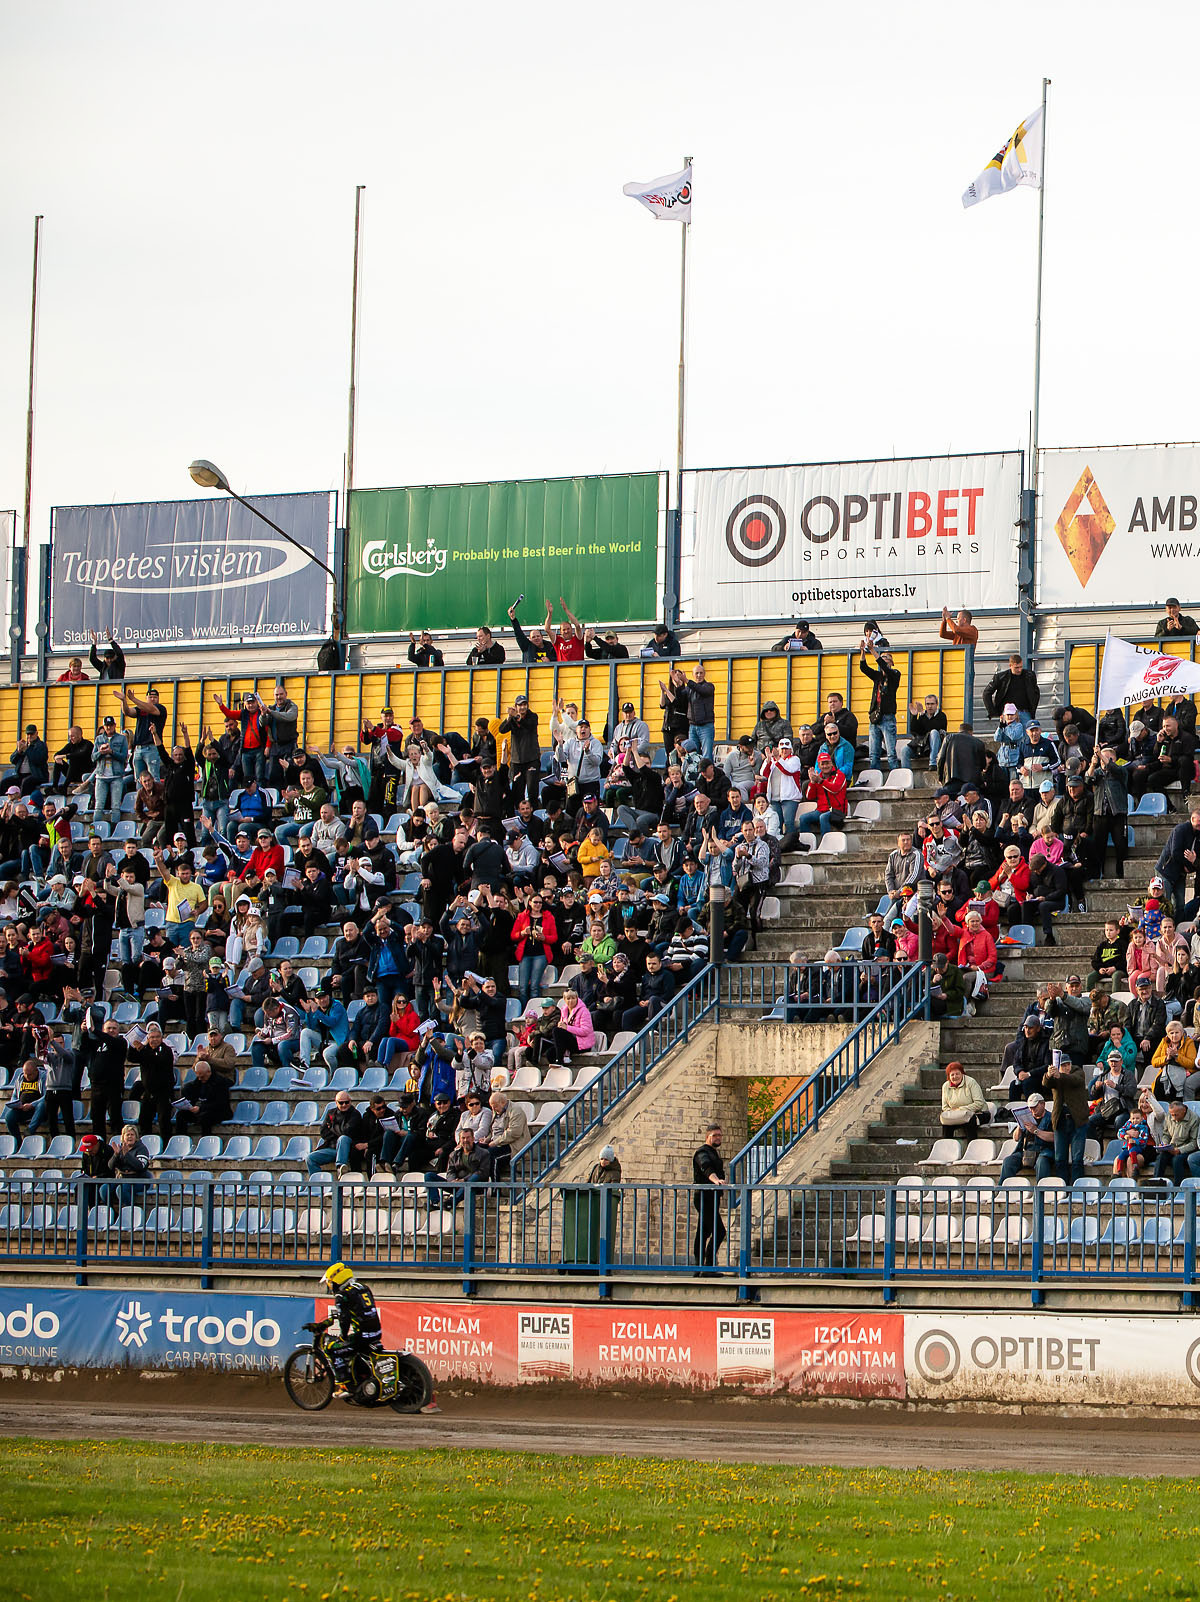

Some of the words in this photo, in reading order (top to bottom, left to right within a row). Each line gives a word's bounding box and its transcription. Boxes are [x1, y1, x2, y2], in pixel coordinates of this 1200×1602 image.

[800, 488, 984, 543] OPTIBET
[362, 540, 448, 578] Carlsberg
[452, 550, 500, 562] Probably
[502, 548, 519, 559] the
[523, 547, 545, 558] Best
[549, 545, 573, 557] Beer
[576, 544, 586, 555] in
[588, 544, 606, 555] the
[609, 541, 641, 553] World
[803, 546, 898, 561] SPORTA
[917, 542, 980, 556] BĀRS
[63, 550, 166, 594] Tapetes
[174, 548, 262, 577] visiem
[792, 584, 916, 604] optibetsportabars.lv
[124, 625, 184, 643] Daugavpils
[192, 619, 310, 638] www.zila-ezerzeme.lv
[1123, 685, 1188, 706] DAUGAVPILS
[362, 1294, 372, 1306] 5
[0, 1303, 59, 1339] do
[159, 1308, 281, 1347] trodo
[417, 1315, 481, 1335] IZCILAM
[521, 1317, 570, 1335] PUFAS
[720, 1321, 771, 1340] PUFAS
[612, 1322, 678, 1340] IZCILAM
[814, 1327, 882, 1344] IZCILAM
[15, 1346, 58, 1358] ONLINE
[405, 1338, 493, 1357] REMONTAM
[521, 1341, 536, 1350] MADE
[538, 1342, 544, 1350] IN
[545, 1341, 570, 1350] GERMANY
[599, 1345, 691, 1364] REMONTAM
[720, 1347, 736, 1355] MADE
[737, 1347, 743, 1355] IN
[745, 1347, 771, 1356] GERMANY
[971, 1335, 1100, 1371] OPTIBET
[165, 1350, 192, 1363] CAR
[194, 1351, 233, 1364] PARTS
[235, 1353, 280, 1367] ONLINE
[801, 1350, 896, 1368] REMONTAM
[600, 1366, 691, 1380] WWW.PUFAS.LV
[803, 1371, 896, 1385] WWW.PUFAS.LV
